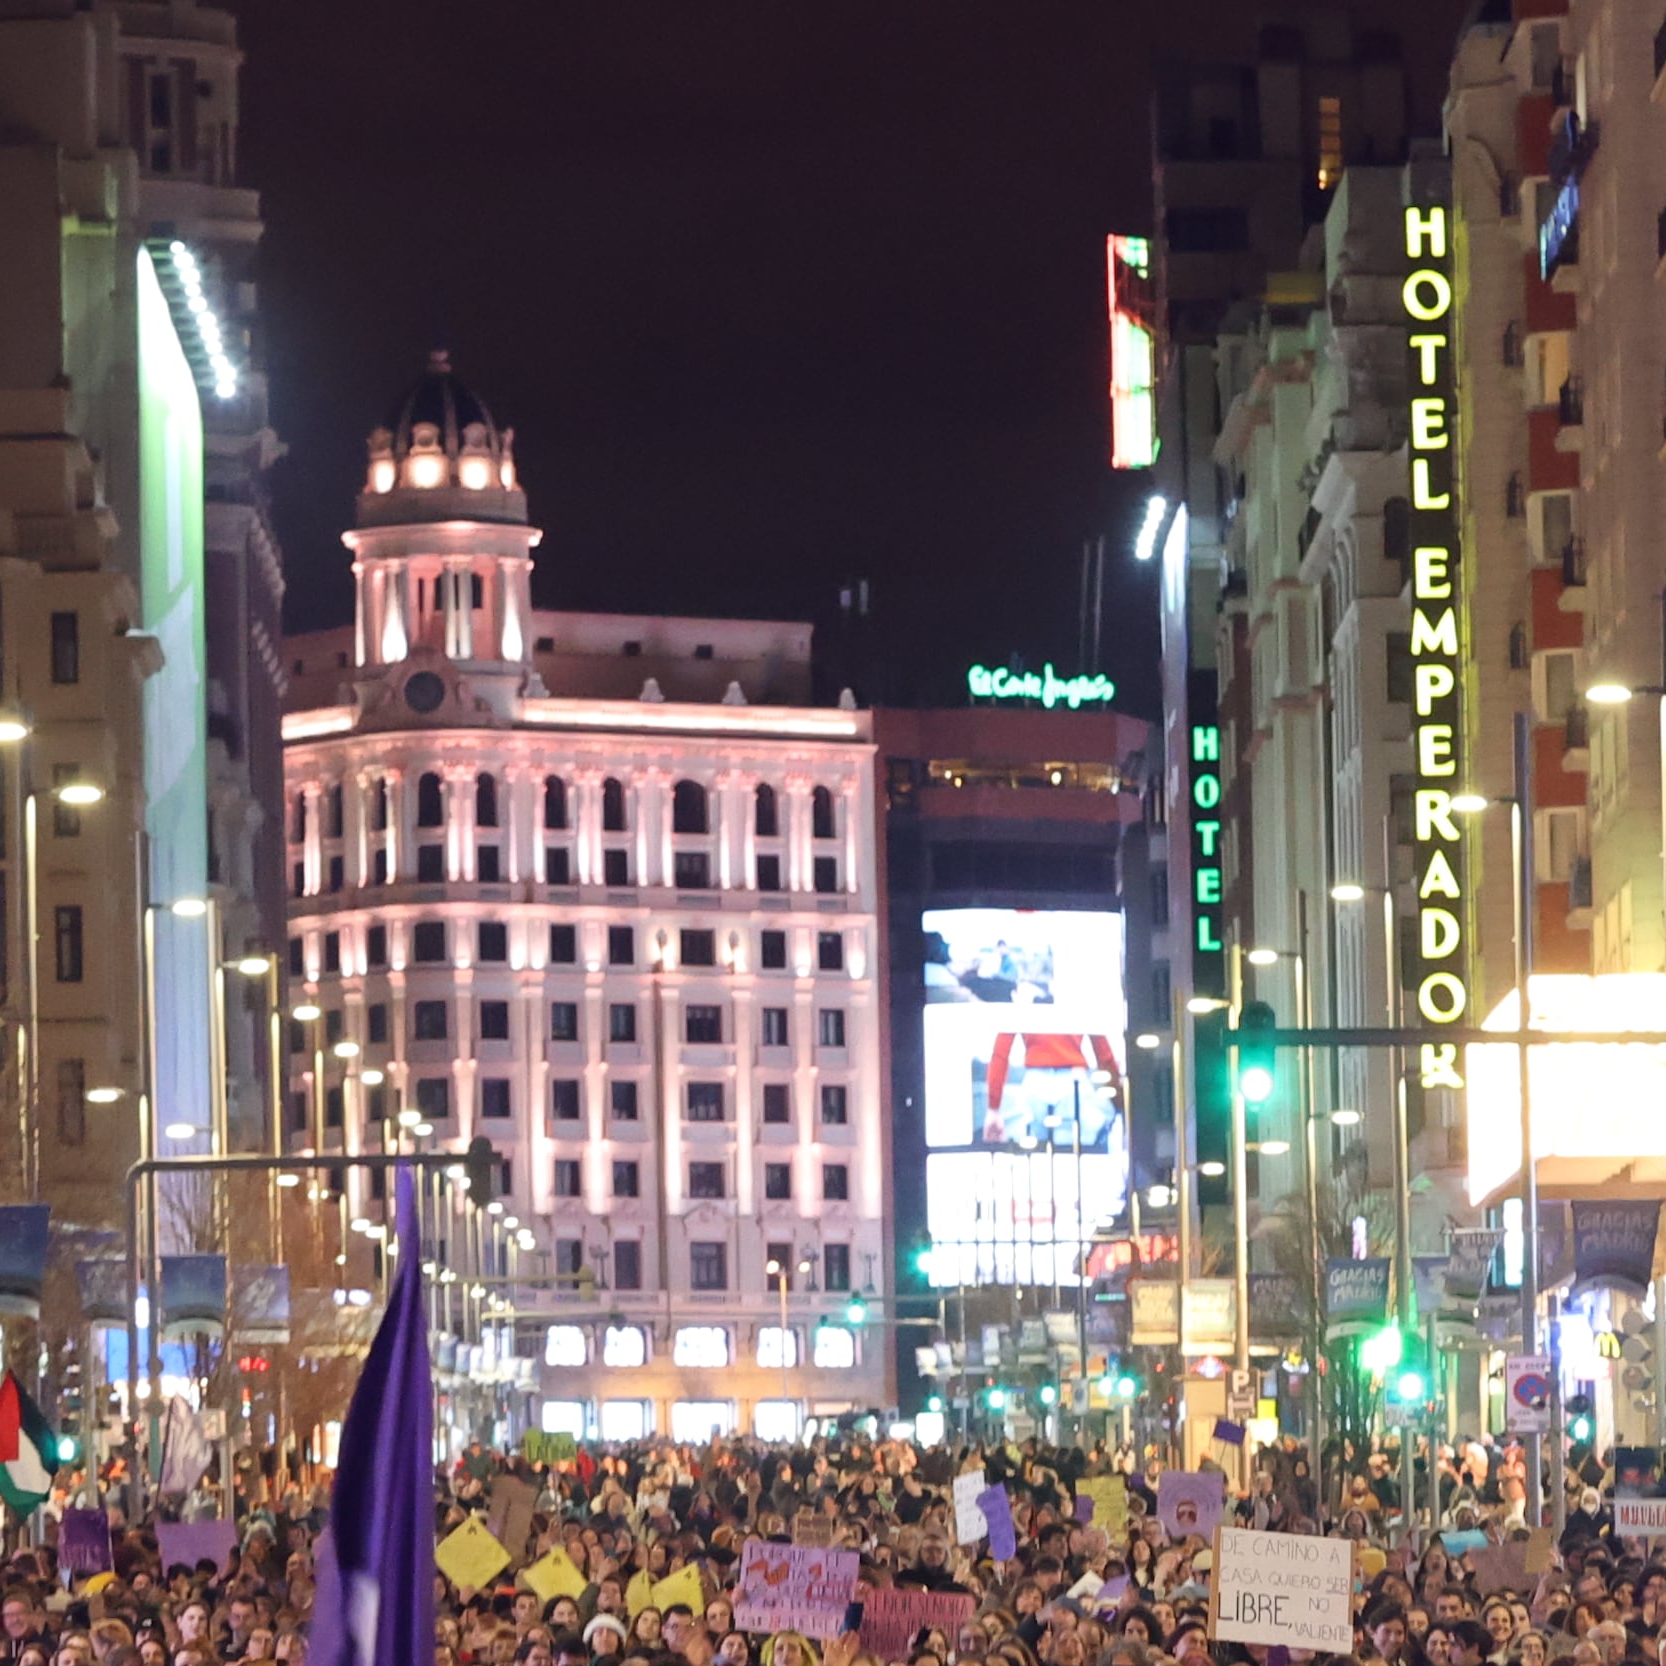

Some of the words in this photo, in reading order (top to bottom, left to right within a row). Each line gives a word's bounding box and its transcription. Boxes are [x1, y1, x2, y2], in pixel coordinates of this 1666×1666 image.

[1402, 207, 1452, 511] HOTEL
[1410, 547, 1464, 1090] EMPERADOR
[1192, 726, 1223, 952] HOTEL
[1221, 1534, 1245, 1556] DE
[1252, 1537, 1320, 1563] CAMINO
[1329, 1548, 1341, 1564] A
[1220, 1565, 1263, 1585] CASA
[1268, 1571, 1321, 1590] QUIERO
[1326, 1578, 1349, 1594] SER
[1217, 1590, 1293, 1629] LIBRE,
[1308, 1597, 1330, 1613] NO
[1294, 1623, 1350, 1643] VALIENTE
